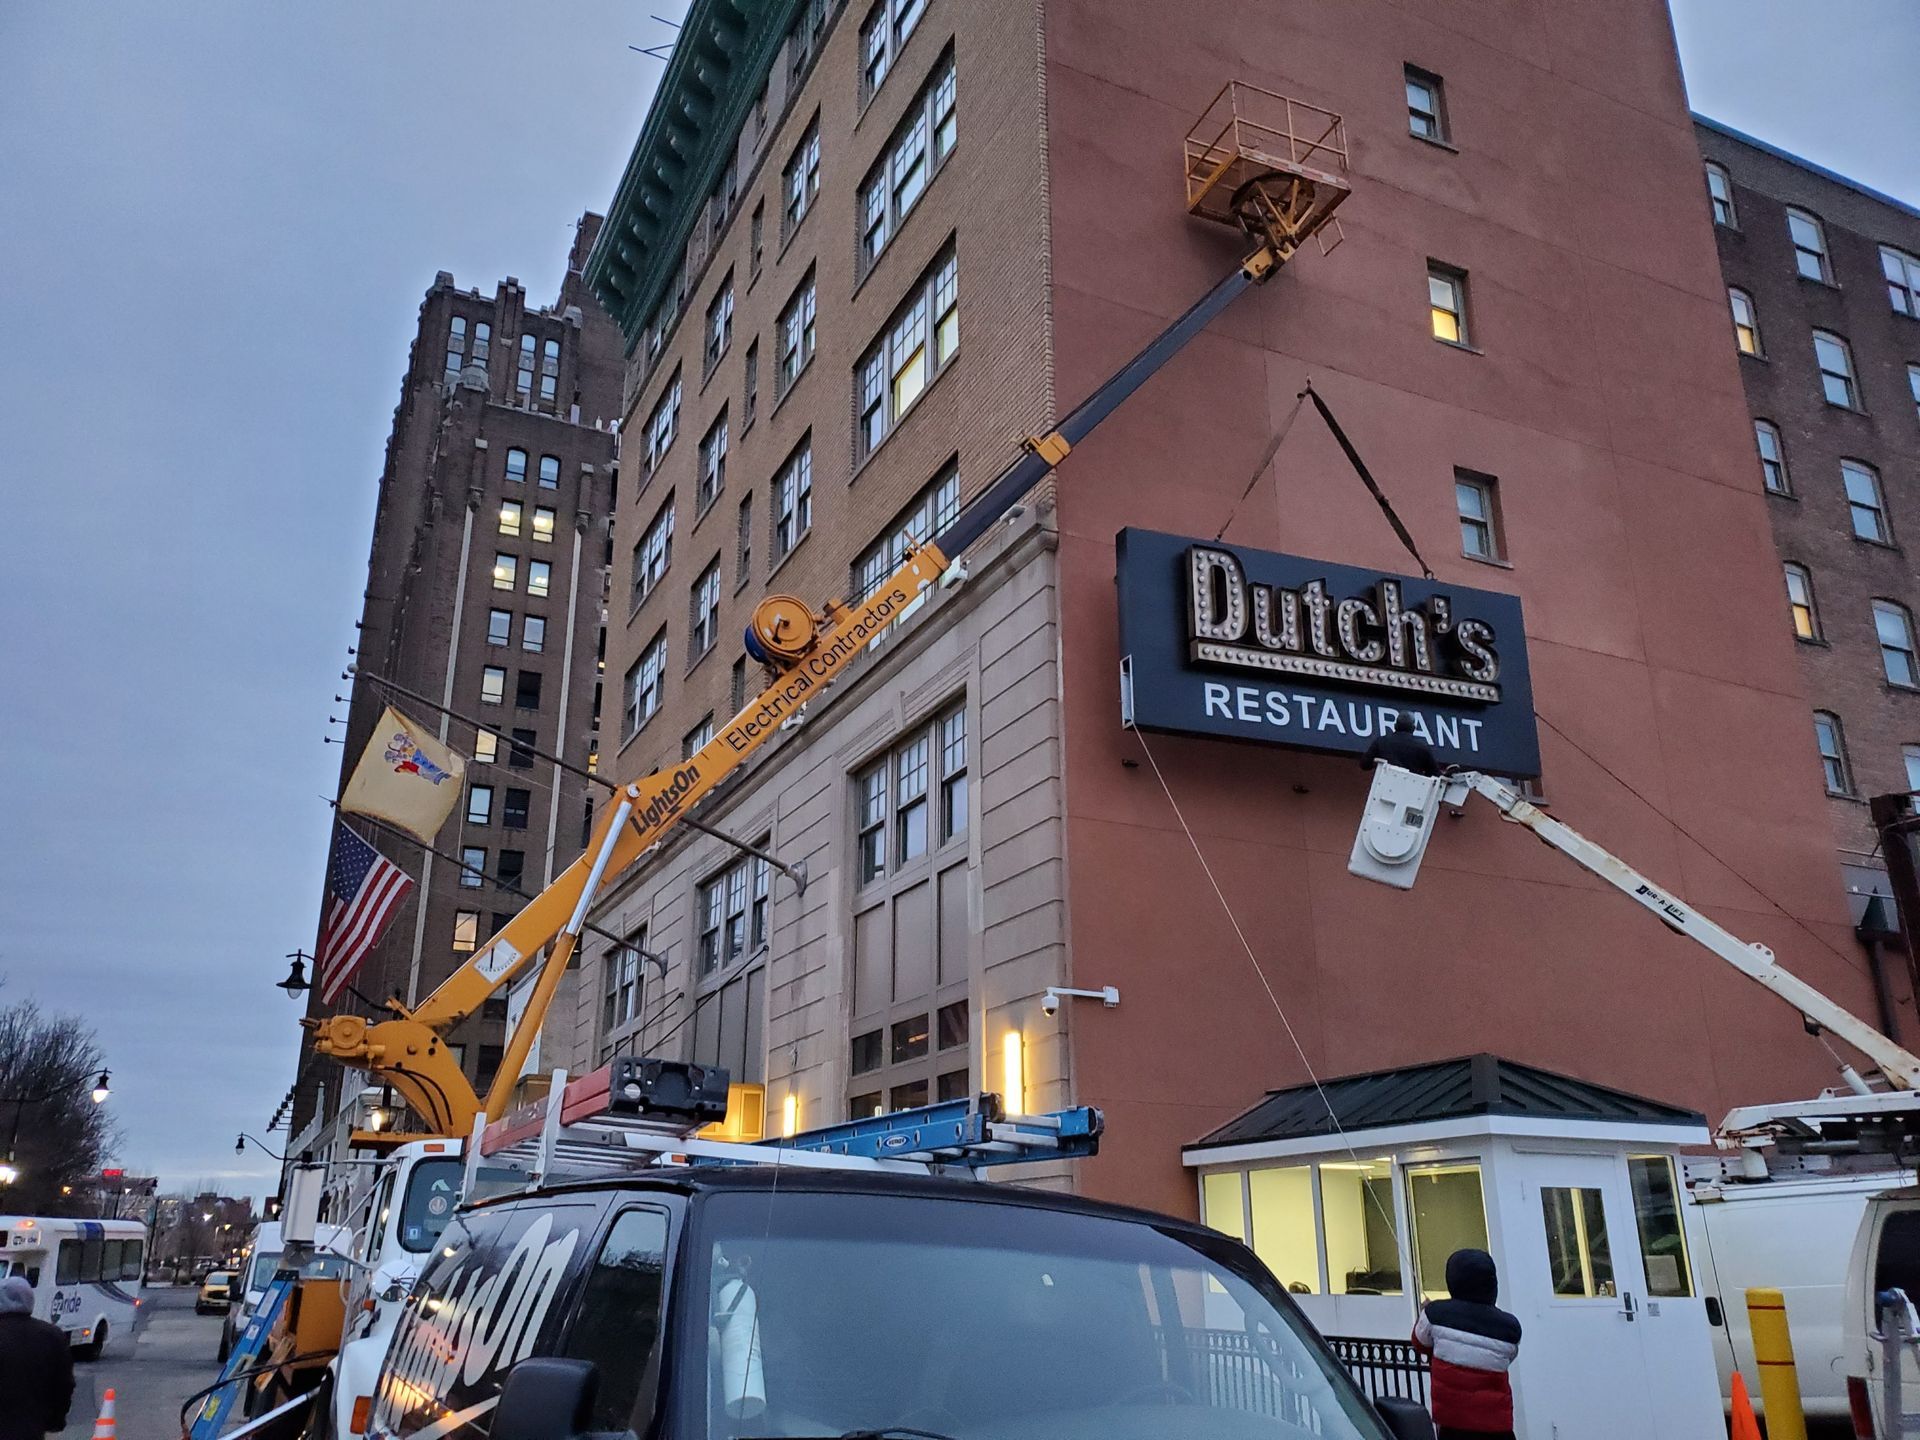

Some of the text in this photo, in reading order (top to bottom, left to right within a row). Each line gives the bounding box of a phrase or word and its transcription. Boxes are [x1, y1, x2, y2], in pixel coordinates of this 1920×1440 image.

[726, 588, 907, 752] Electrical Contractors
[1187, 544, 1500, 683] Dutch's
[630, 765, 701, 836] LightsOn
